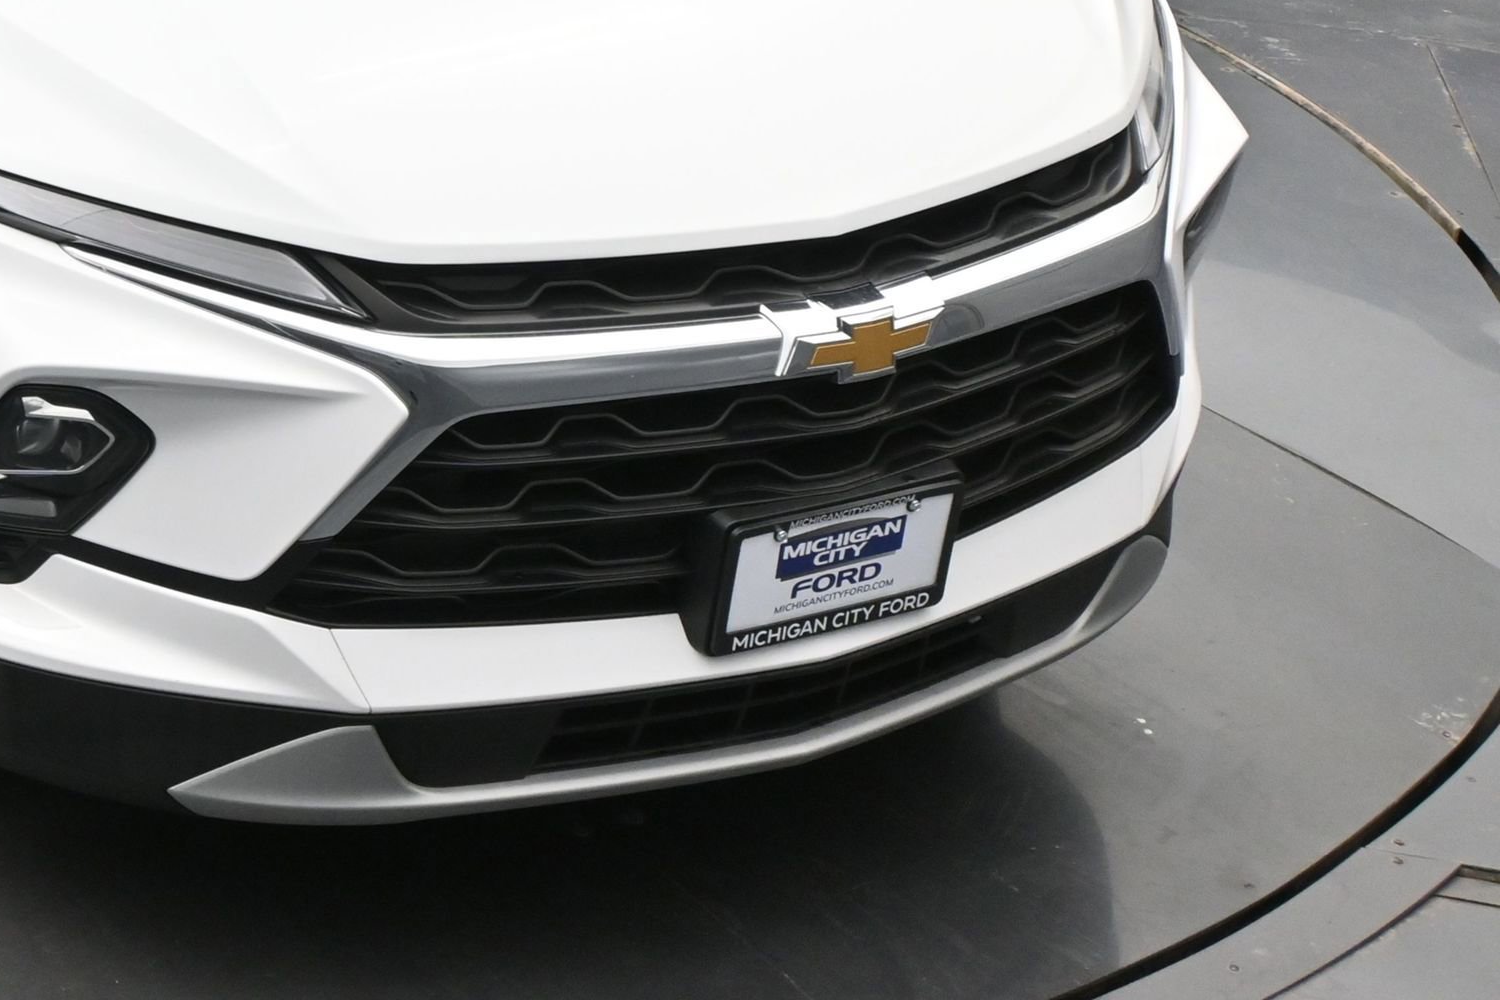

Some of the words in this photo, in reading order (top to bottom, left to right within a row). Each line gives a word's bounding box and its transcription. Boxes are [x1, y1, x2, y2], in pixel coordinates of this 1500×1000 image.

[782, 519, 902, 560] MICHIGAN
[813, 542, 868, 566] CITY
[773, 578, 894, 614] MICHIGANCITYFORD.COM
[791, 562, 882, 599] FORD
[731, 616, 828, 651] MICHIGAN
[832, 605, 876, 629] CITY
[878, 592, 930, 616] FORD
